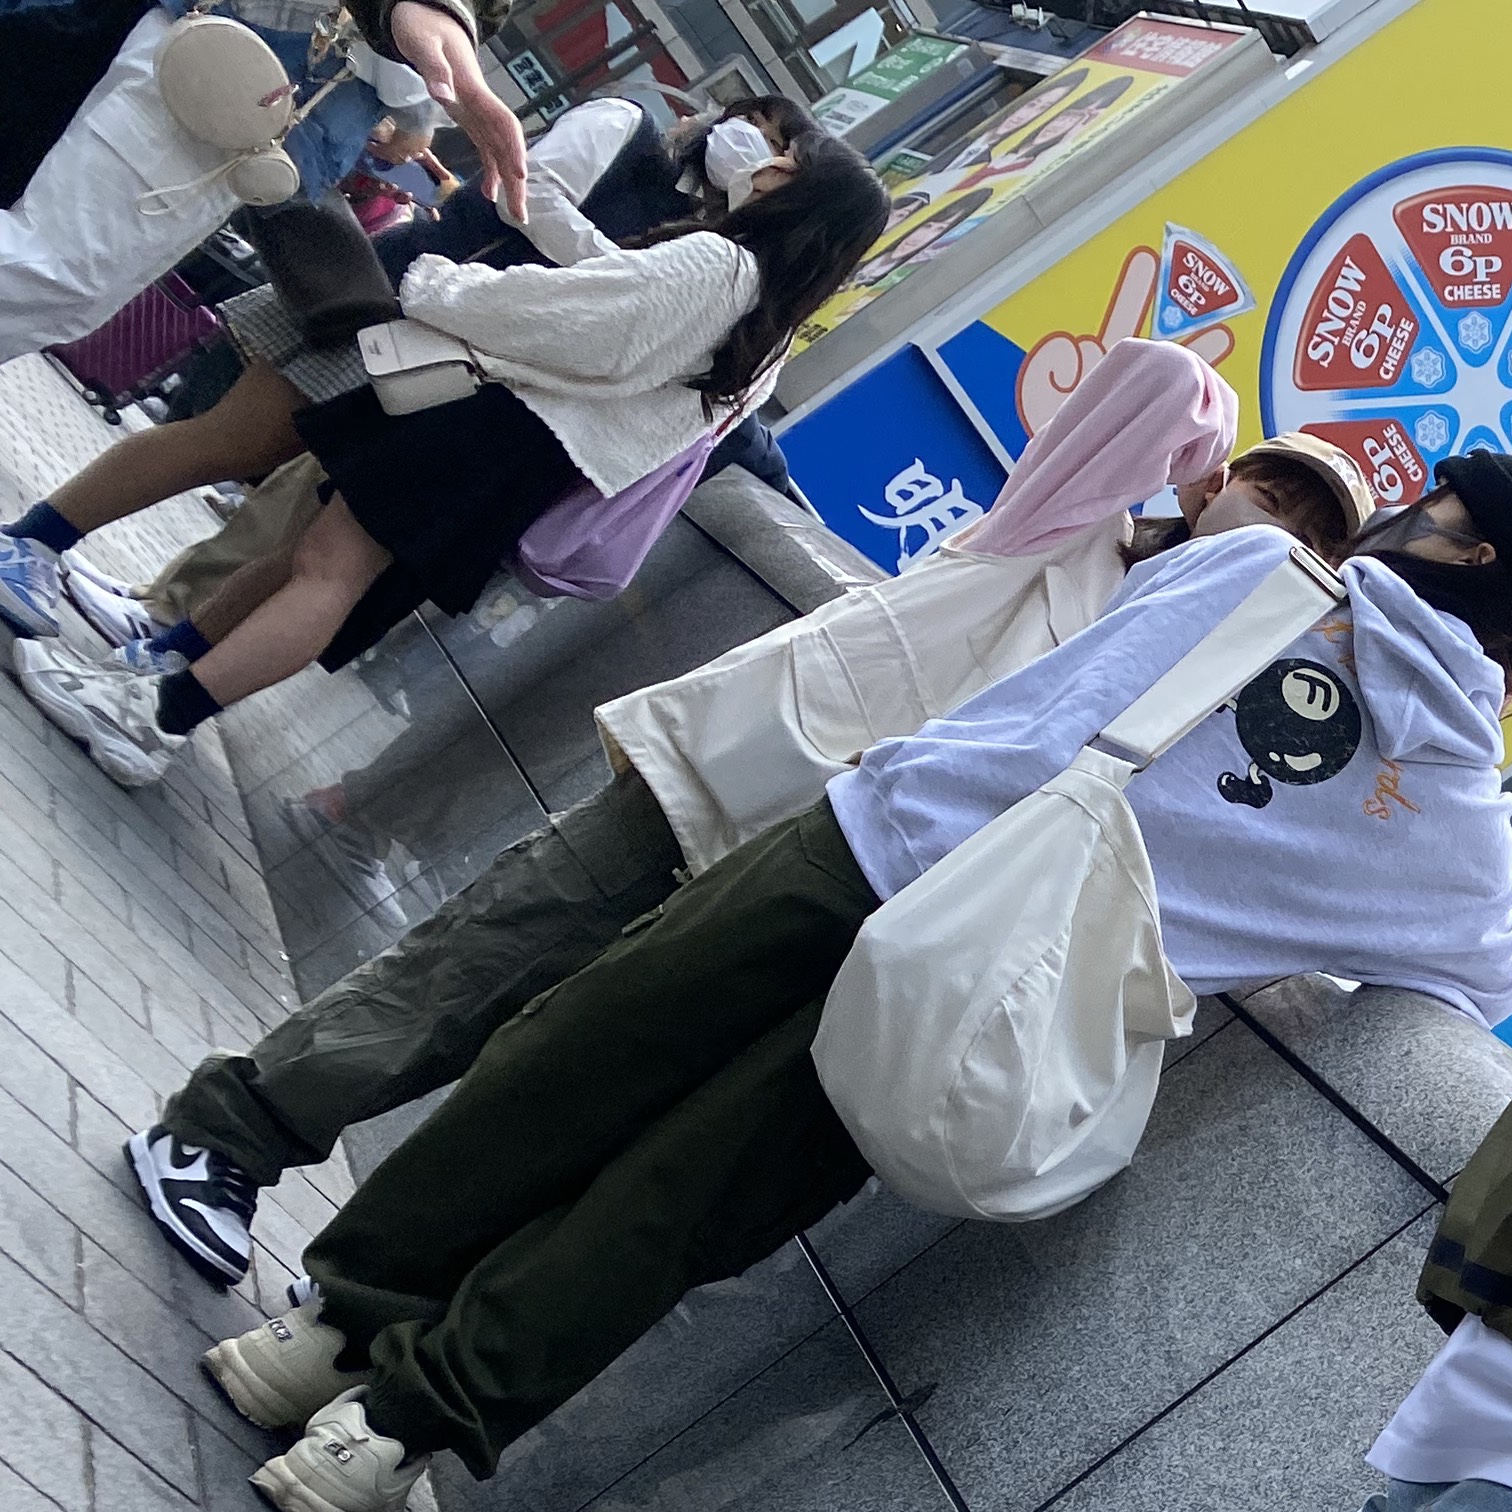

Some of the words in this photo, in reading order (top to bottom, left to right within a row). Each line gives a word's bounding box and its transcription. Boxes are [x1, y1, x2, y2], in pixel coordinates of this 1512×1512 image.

[1450, 233, 1492, 245] BRAND
[1182, 251, 1230, 296] SNOW
[1438, 246, 1502, 283] 6P
[1178, 274, 1206, 306] 6P
[1307, 256, 1368, 368] SNOW
[1444, 284, 1501, 301] CHEESE
[1342, 301, 1368, 346] BRAND
[1349, 303, 1396, 370] 6P
[1379, 317, 1414, 381] CHEESE
[1363, 437, 1404, 501] 6P
[1382, 423, 1423, 483] CHEESE
